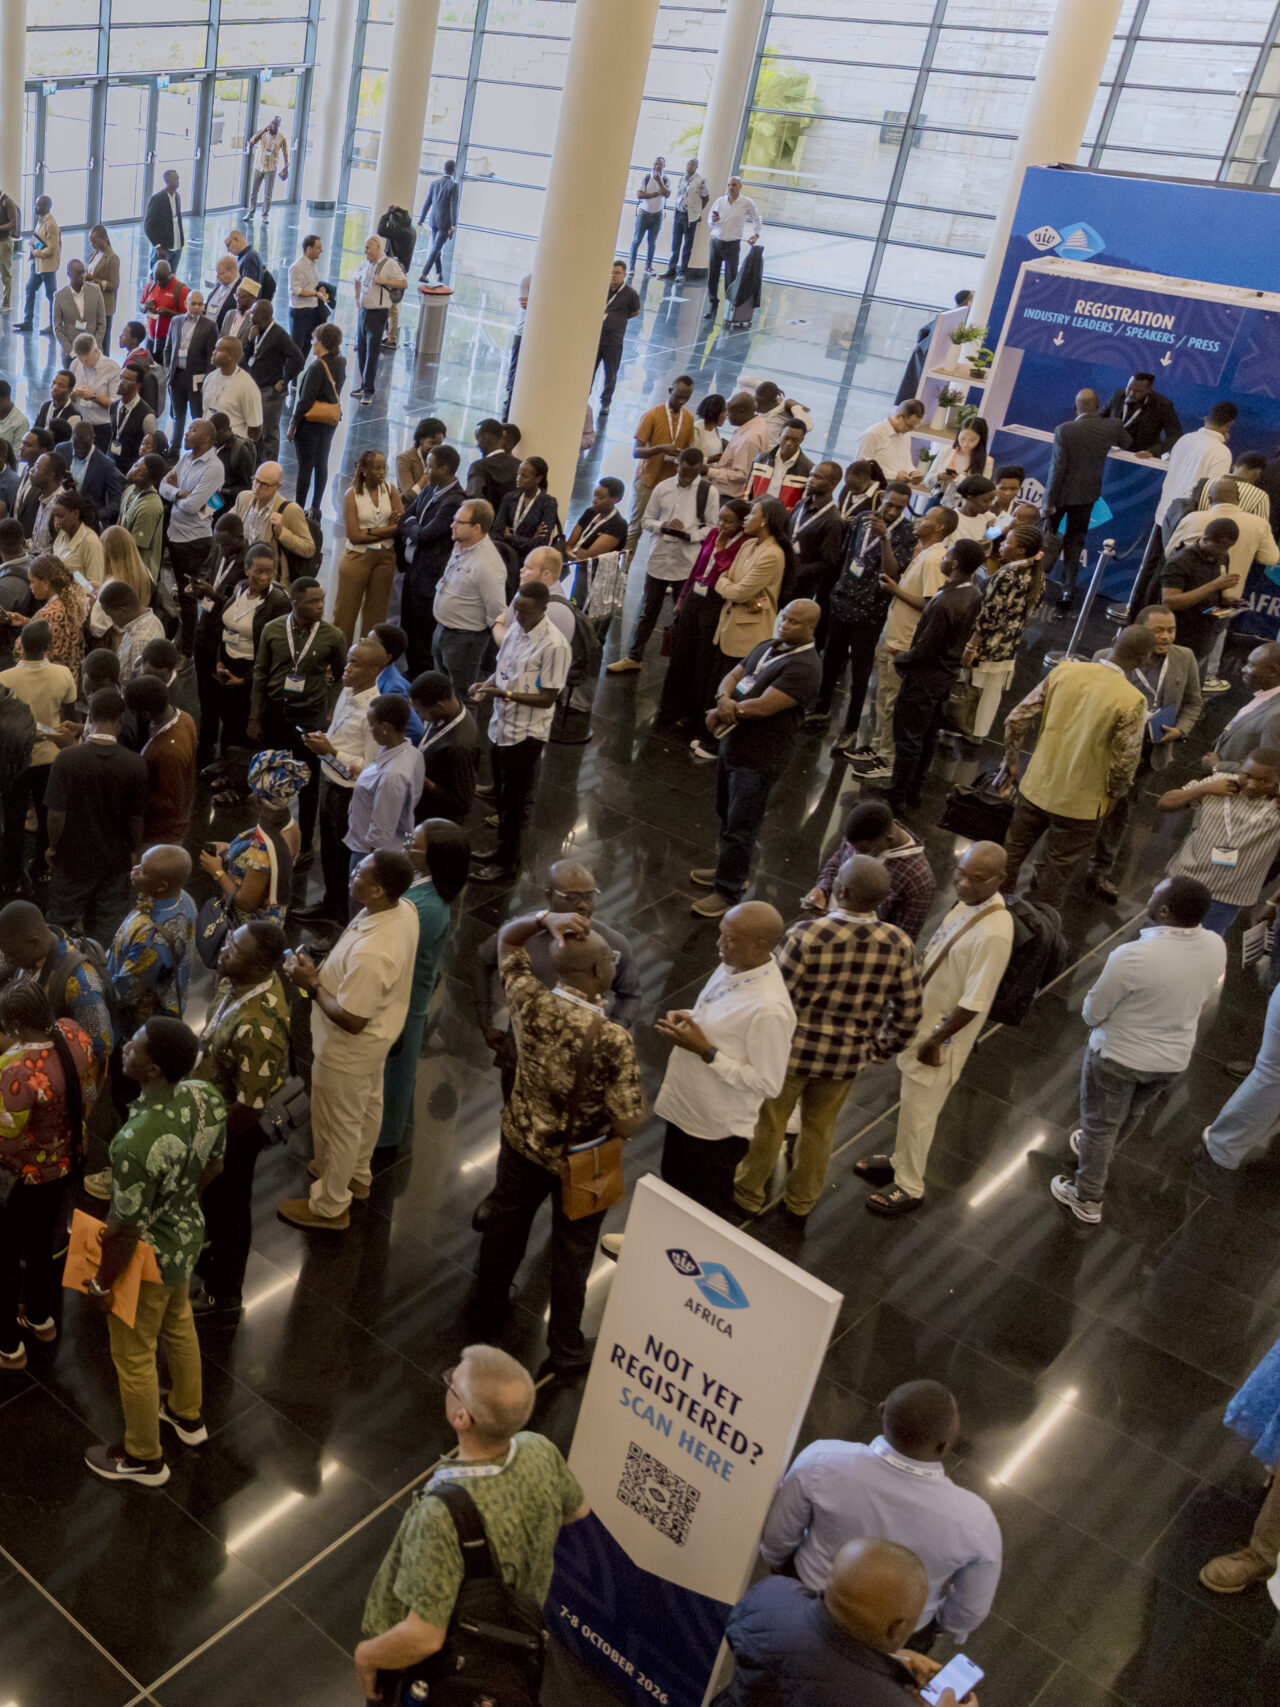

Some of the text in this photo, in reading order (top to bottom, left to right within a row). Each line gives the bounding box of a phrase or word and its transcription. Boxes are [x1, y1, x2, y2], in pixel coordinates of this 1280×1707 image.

[1023, 307, 1221, 353] INDUSTRY LEADERS / SPEAKERS / PRESS
[1074, 299, 1175, 330] REGISTRATION
[683, 1297, 732, 1339] AFRICA
[610, 1343, 764, 1466] REGISTERED?
[644, 1333, 743, 1417] NOT YET
[620, 1386, 735, 1482] SCAN HERE
[560, 1605, 669, 1705] 7-8 OCTOBER 2026
